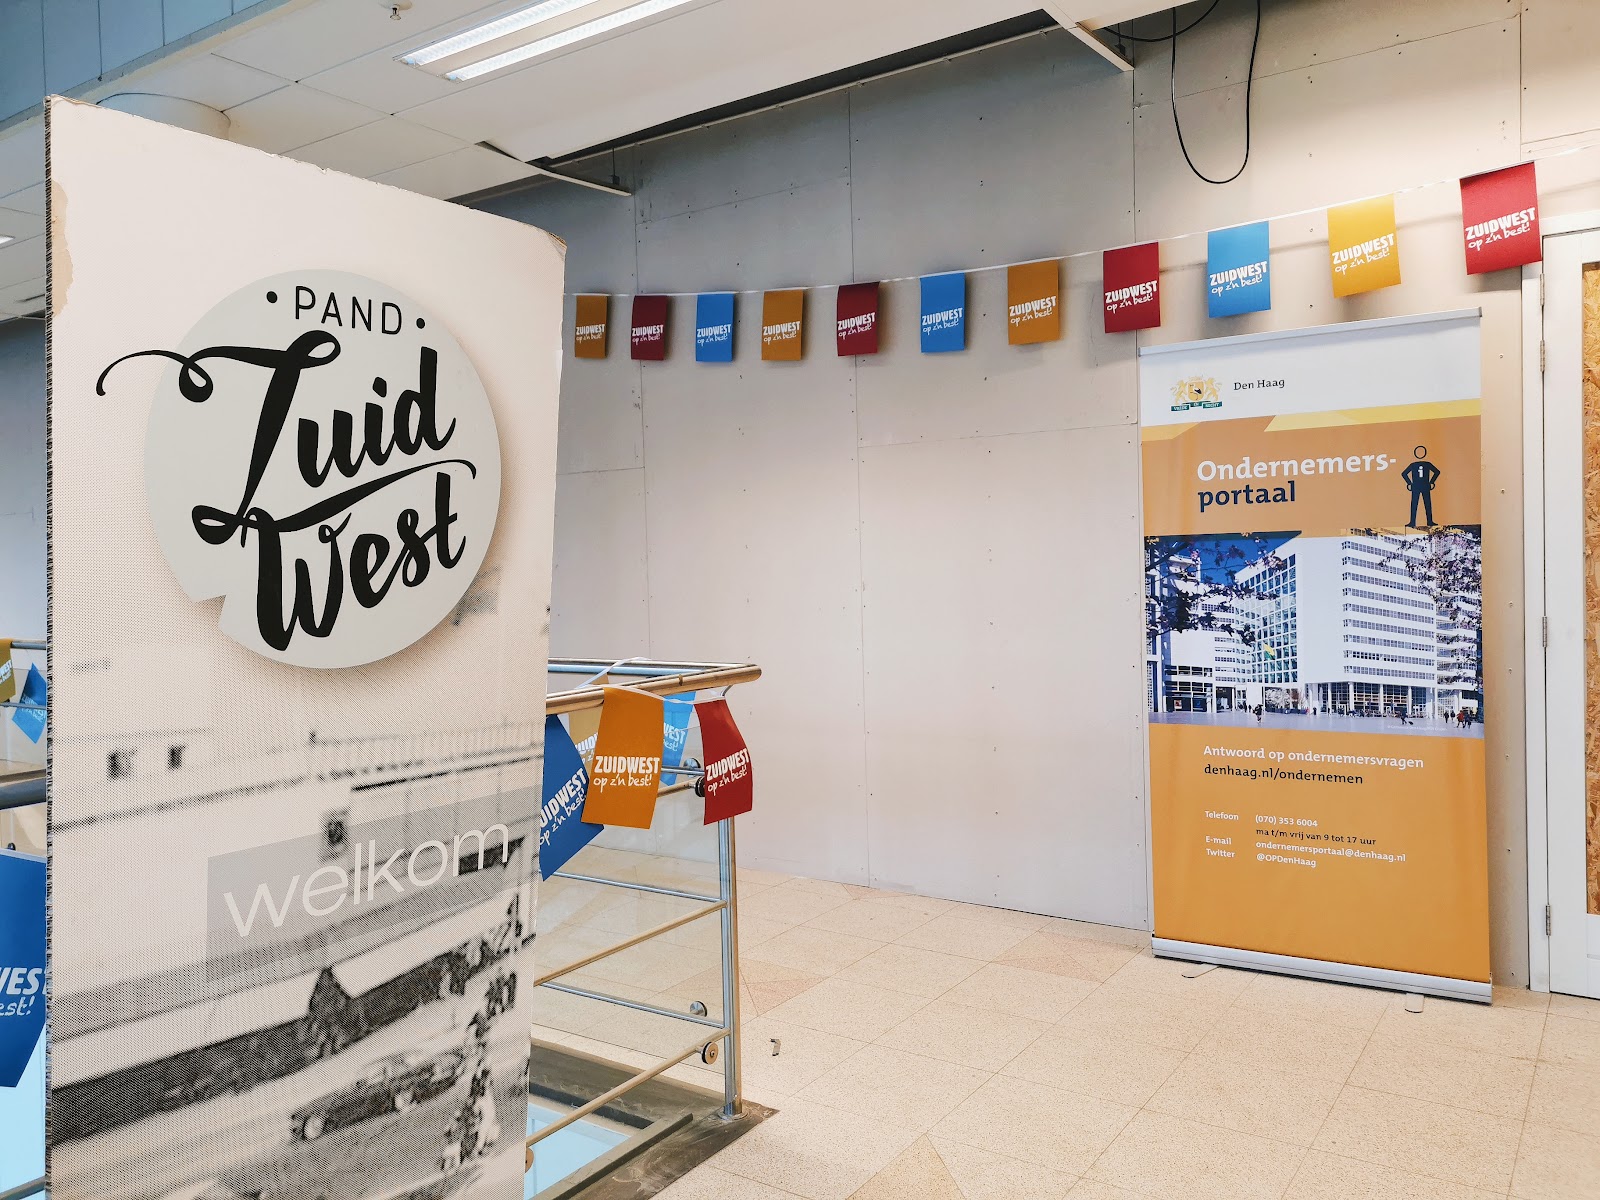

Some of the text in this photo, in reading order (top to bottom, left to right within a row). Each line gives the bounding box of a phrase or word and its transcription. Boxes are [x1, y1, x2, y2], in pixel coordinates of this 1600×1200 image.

[1465, 207, 1535, 240] ZUIDWEST
[1468, 222, 1530, 251] op z'n best!
[1332, 233, 1394, 264] ZUIDWEST
[1210, 261, 1267, 286] ZUIDWEST
[1335, 249, 1390, 275] op z'n best!
[1105, 280, 1158, 303] ZUIDWEST
[1211, 273, 1262, 297] op z'n best!
[295, 286, 402, 335] PAND
[1009, 296, 1056, 316] ZUIDWEST
[1107, 292, 1153, 314] op z'n best!
[763, 321, 800, 335] ZUIDWEST
[837, 312, 875, 330] ZUIDWEST
[922, 308, 963, 325] ZUIDWEST
[923, 327, 931, 335] op
[943, 318, 959, 328] best!
[1010, 317, 1020, 327] op
[1034, 307, 1052, 318] best!
[576, 324, 605, 335] ZUIDWEST
[632, 325, 664, 336] ZUIDWEST
[697, 324, 731, 338] ZUIDWEST
[838, 331, 847, 340] op
[857, 323, 872, 333] best!
[1234, 379, 1285, 391] Den Haag
[96, 330, 477, 545] Zuid
[1197, 453, 1396, 482] Ondernemers-
[1197, 480, 1296, 513] portaal
[241, 472, 467, 651] West
[594, 756, 660, 774] ZUIDWEST
[706, 748, 749, 781] ZUIDWEST
[1203, 745, 1424, 771] Antwoord op ondernemersvragen
[593, 774, 653, 793] op z'n best!
[707, 765, 748, 797] op z'n best!
[1204, 763, 1363, 784] denhaag.nl/ondernemen
[540, 768, 587, 829] UIDWEST
[551, 815, 566, 832] z'n
[564, 788, 587, 817] best!
[1205, 810, 1239, 820] Telefoon
[1255, 814, 1276, 825] (070)
[1296, 819, 1318, 827] 6004
[1271, 829, 1288, 837] t/m
[1290, 831, 1304, 840] vrij
[1331, 834, 1344, 842] tot
[1205, 836, 1406, 862] E-mail ondernemersportaal@denhaag.nl
[1206, 848, 1316, 868] Twitter @OPDenHaag
[224, 823, 509, 938] welkom
